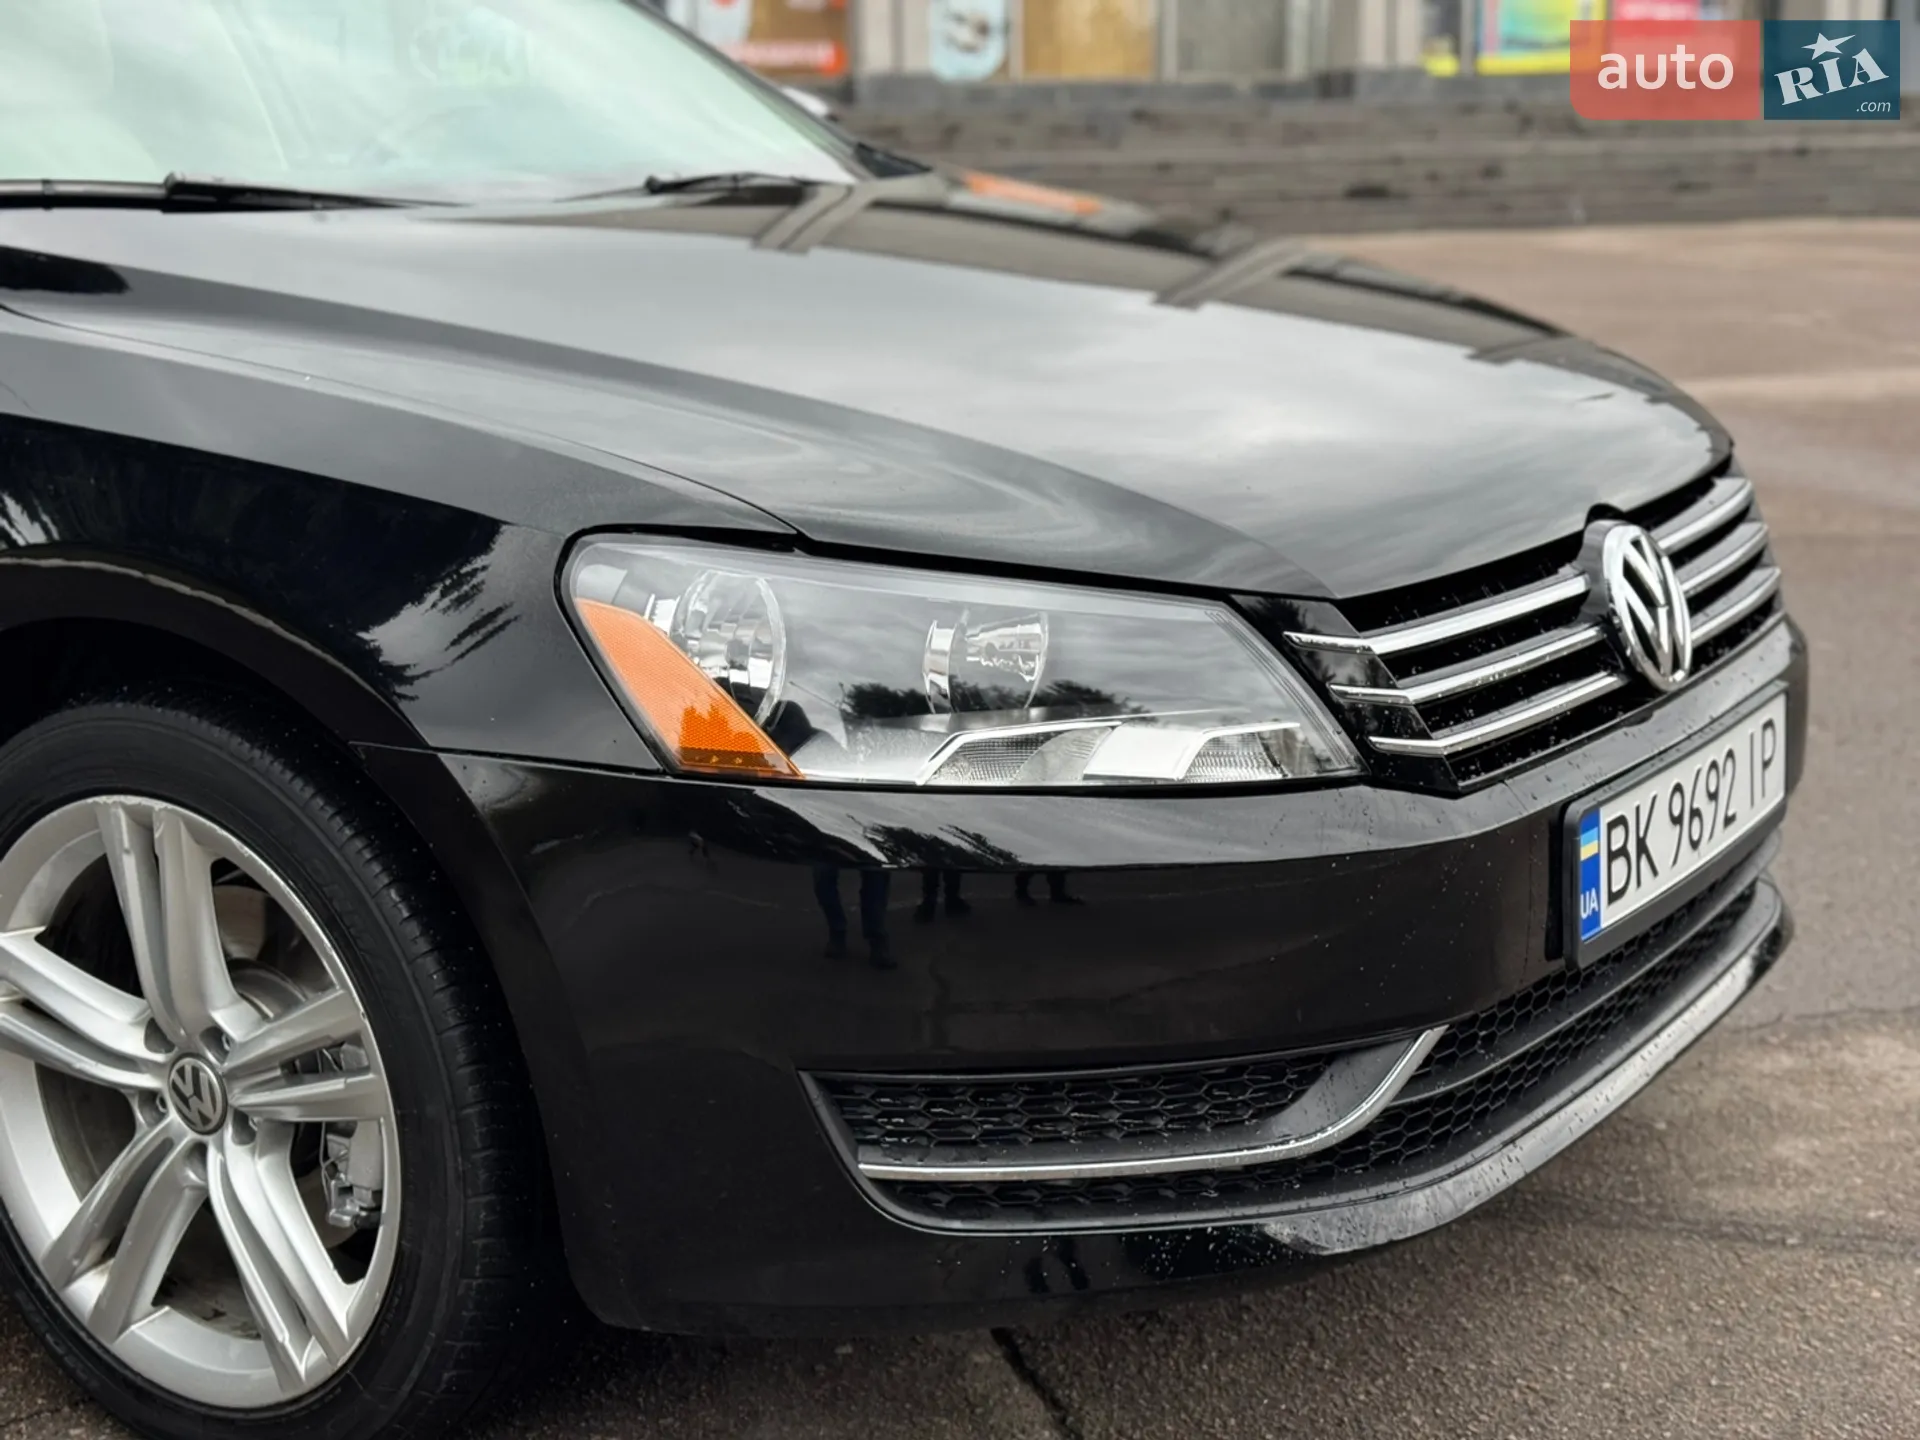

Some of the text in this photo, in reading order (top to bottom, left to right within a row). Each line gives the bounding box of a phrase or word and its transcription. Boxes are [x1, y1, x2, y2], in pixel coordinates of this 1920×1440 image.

[1606, 717, 1777, 907] BK 9692 IP
[1580, 887, 1599, 919] UA
